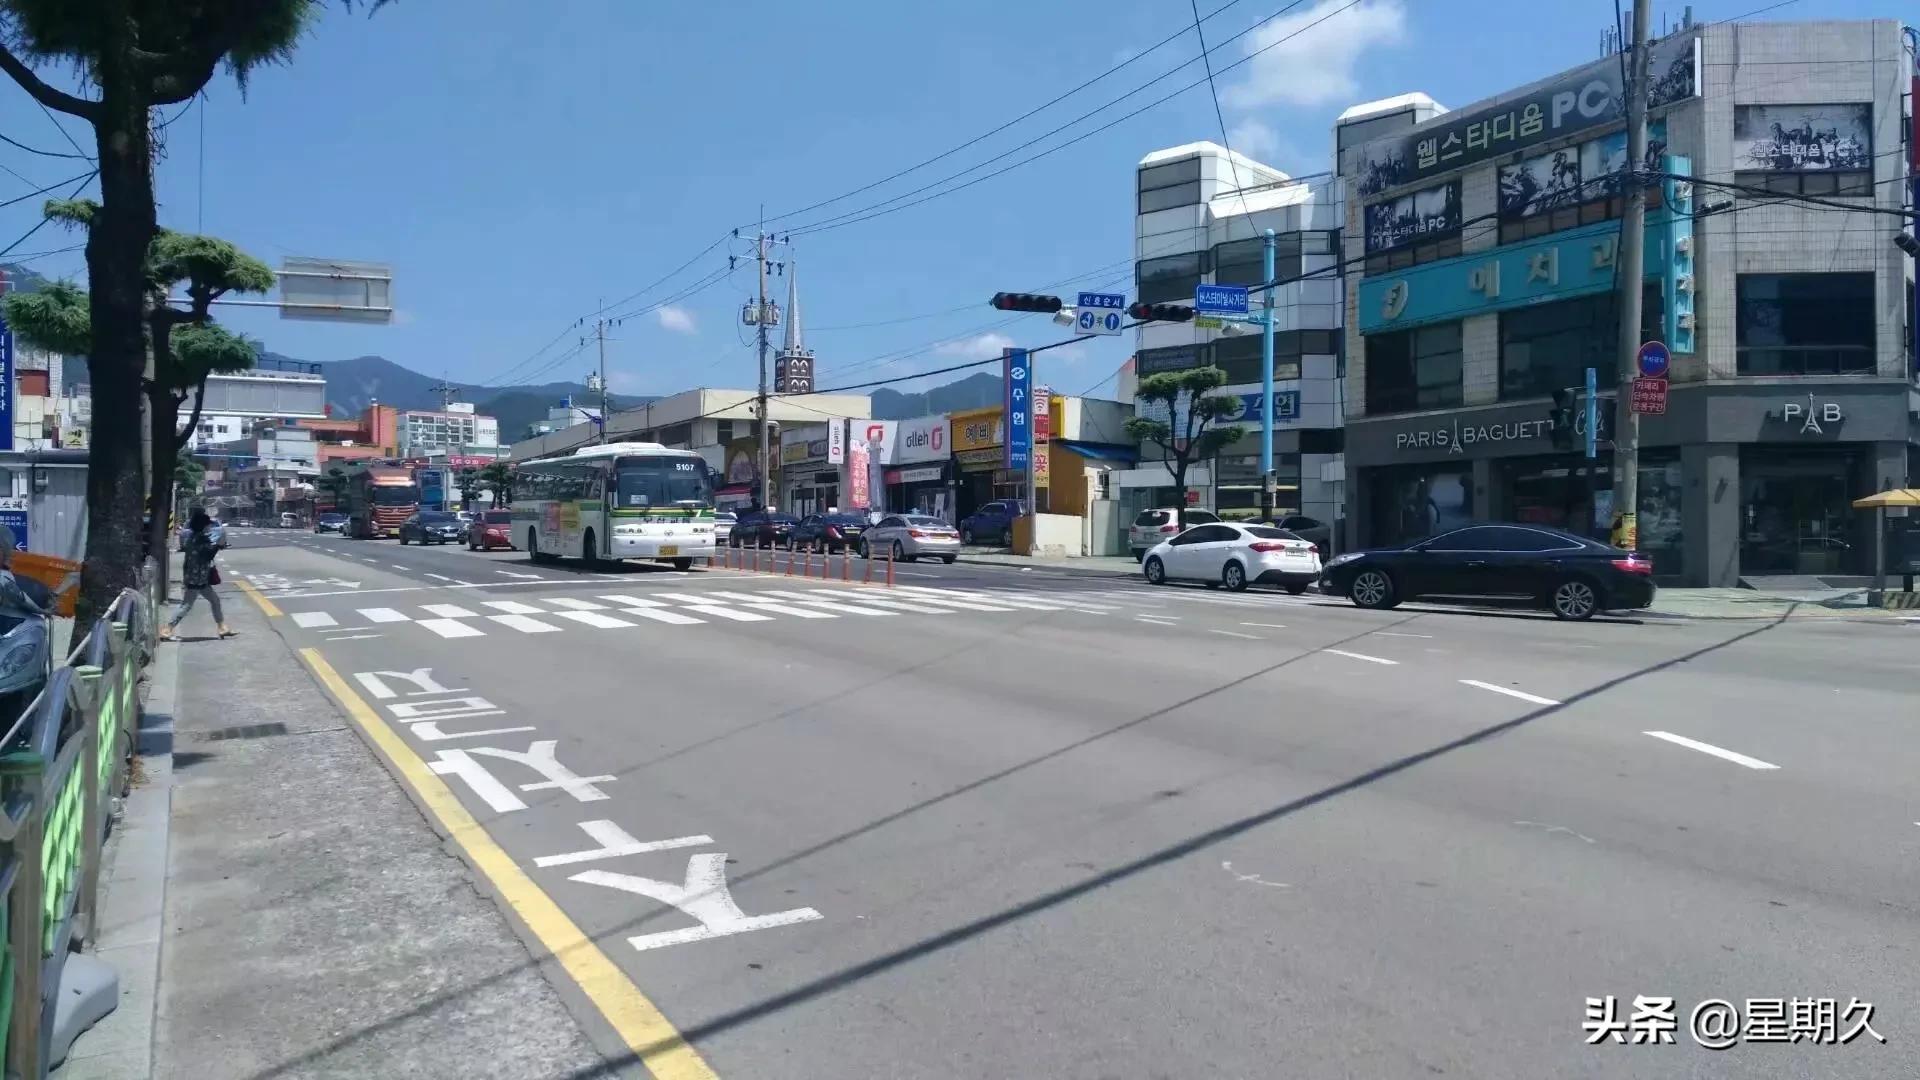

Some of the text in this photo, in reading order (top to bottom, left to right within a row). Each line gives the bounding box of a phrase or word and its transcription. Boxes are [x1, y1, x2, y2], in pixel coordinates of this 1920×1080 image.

[1416, 79, 1611, 169] 웹스타디움 PC
[1428, 215, 1446, 232] PC
[1083, 295, 1120, 307] 신호순서
[1634, 381, 1659, 391] 카메라
[906, 431, 929, 448] olleh
[1397, 419, 1555, 448] PARIS BAGUETT
[676, 463, 695, 471] 5107
